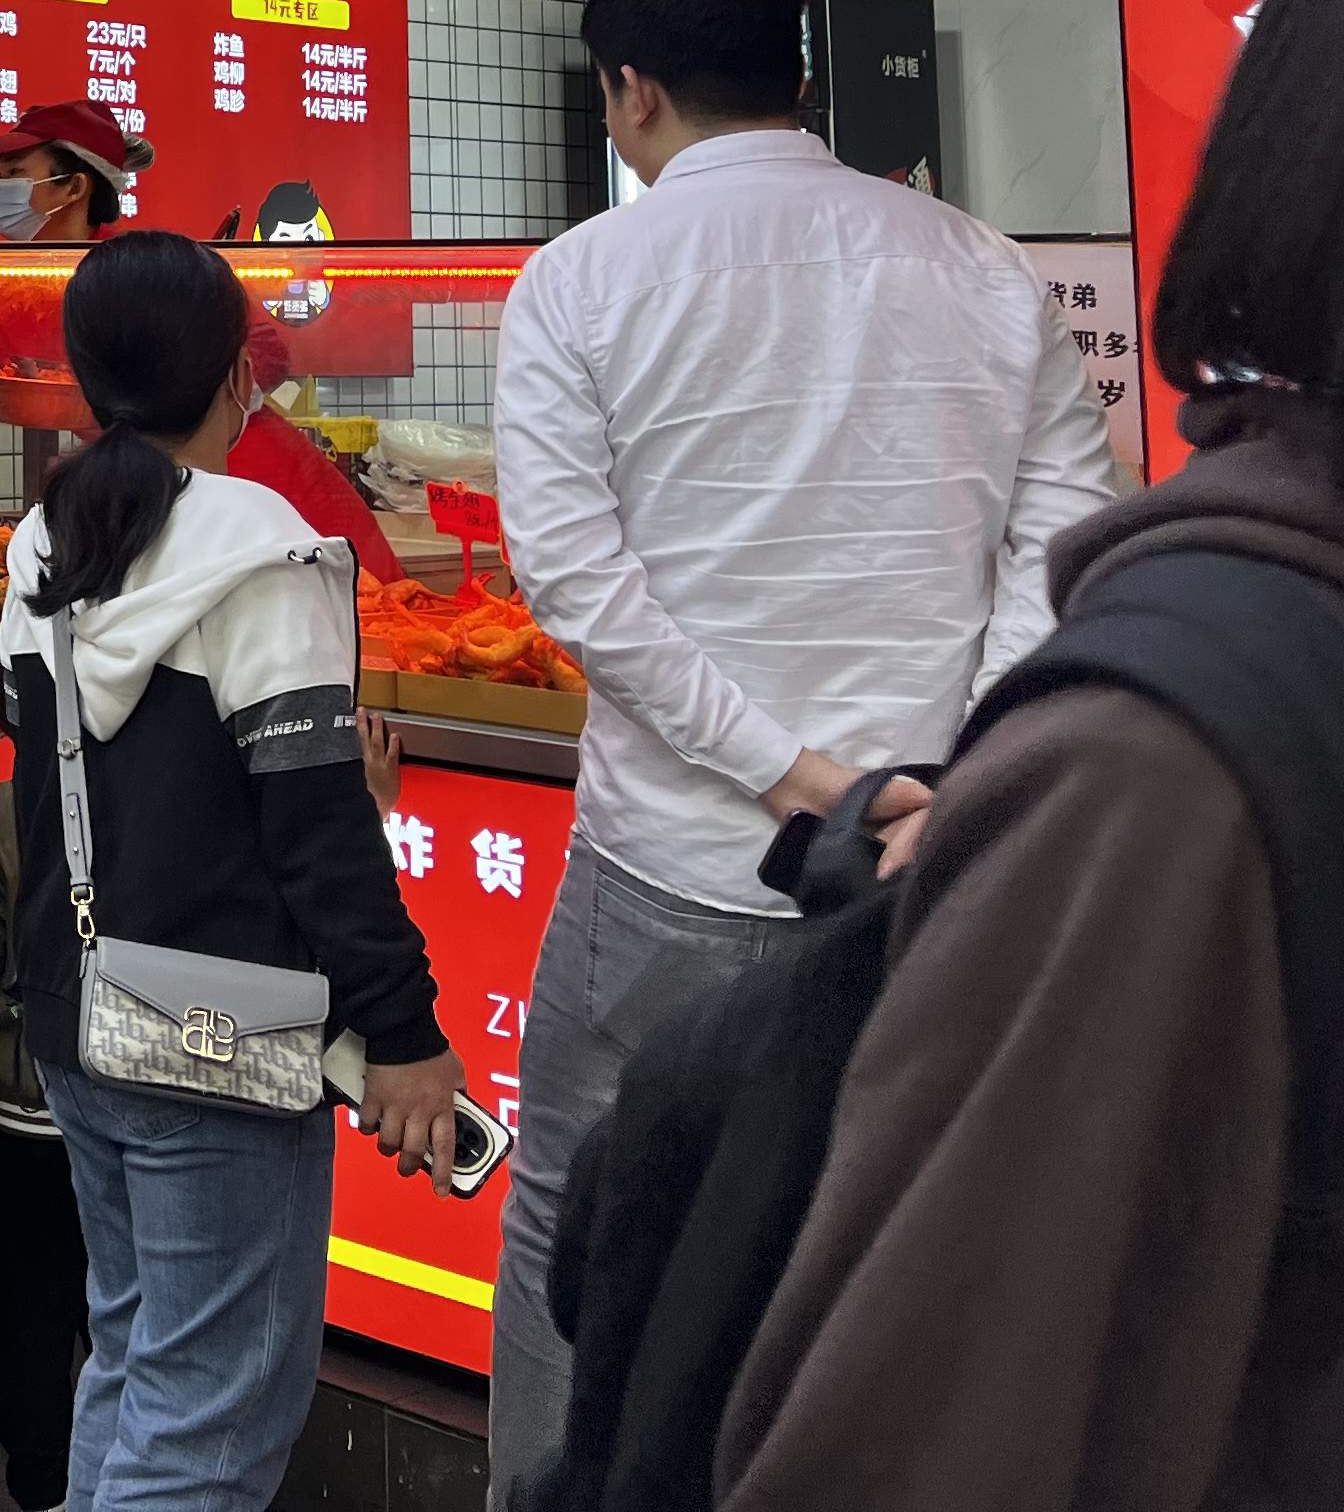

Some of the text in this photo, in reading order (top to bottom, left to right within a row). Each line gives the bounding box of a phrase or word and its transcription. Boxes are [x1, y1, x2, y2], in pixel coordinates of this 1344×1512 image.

[86, 20, 147, 49] 23元/只
[87, 49, 136, 76] 7元/个
[214, 32, 368, 70] 炸鱼 14元/半斤
[214, 60, 368, 96] 鸡柳 14元/半斤
[882, 54, 920, 79] 小货柜
[87, 78, 137, 105] 8元/对
[302, 96, 368, 123] 14元/半斤
[1071, 330, 1139, 359] 职多
